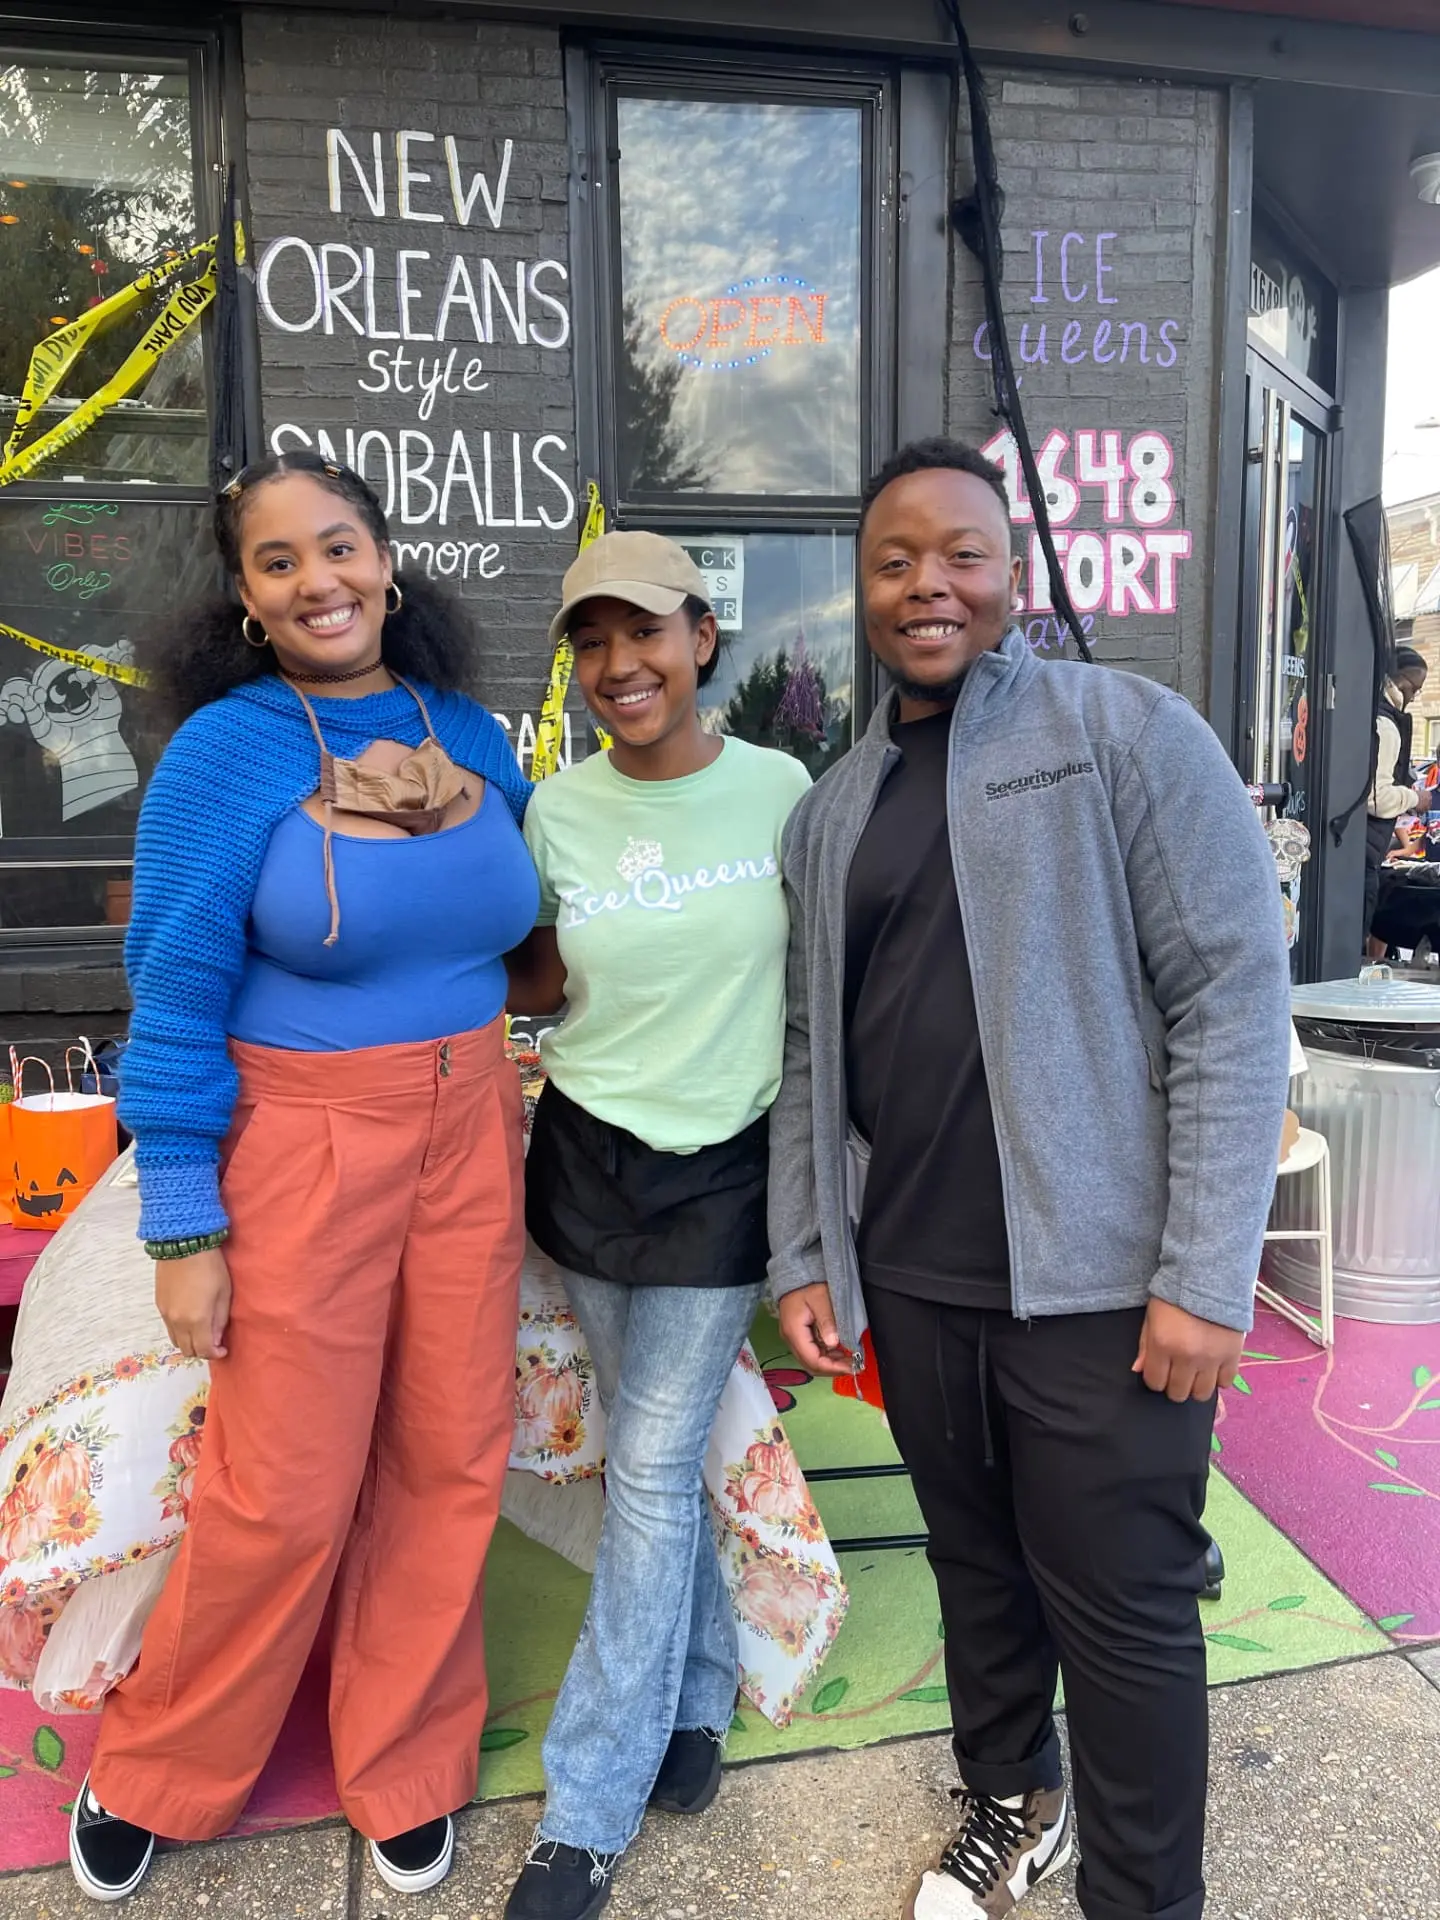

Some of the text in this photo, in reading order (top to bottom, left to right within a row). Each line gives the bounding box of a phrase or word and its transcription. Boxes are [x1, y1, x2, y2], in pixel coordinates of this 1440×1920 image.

[327, 129, 513, 228] NEW
[176, 283, 212, 316] YOU
[257, 237, 569, 349] ORLEANS
[1030, 231, 1118, 304] ICE
[659, 293, 828, 350] OPEN
[979, 427, 1176, 527] 1648
[24, 528, 132, 561] VIBES
[389, 541, 505, 581] more
[1028, 529, 1192, 617] FORT
[46, 563, 112, 599] Only
[985, 762, 1094, 796] Securityplus
[558, 854, 779, 929] Ice Queens
